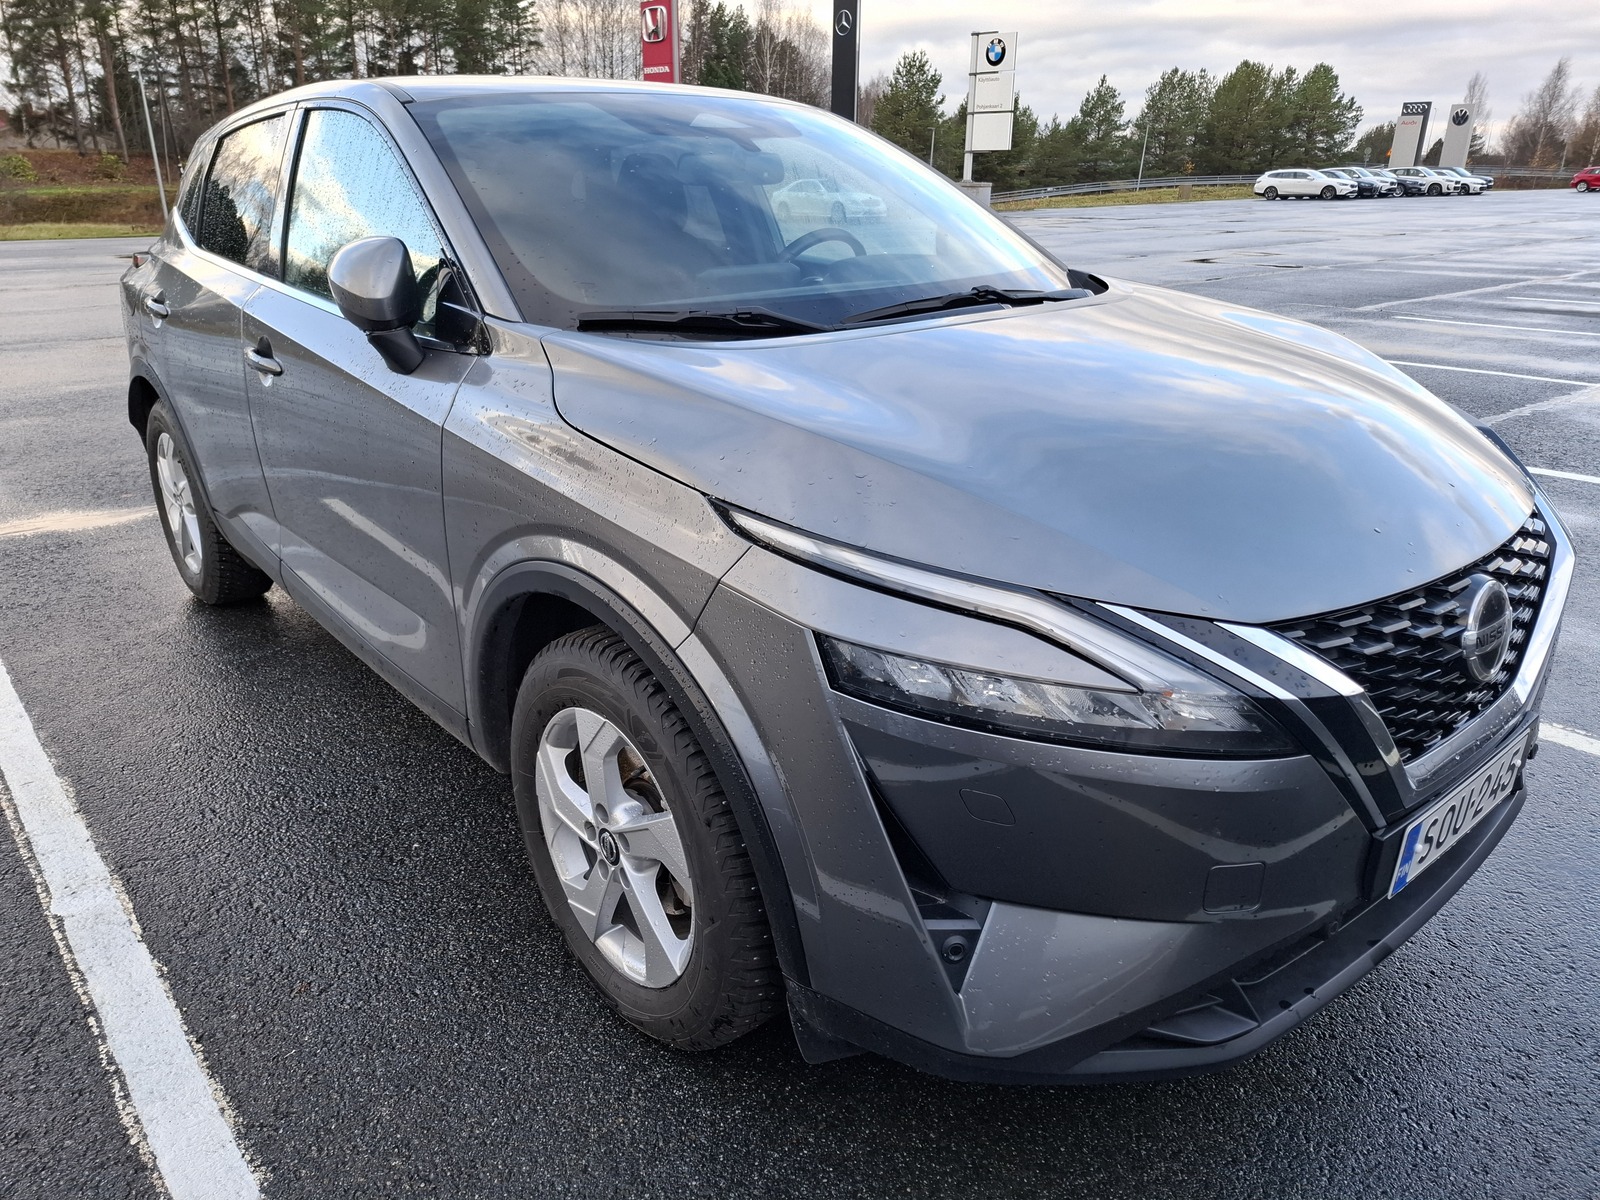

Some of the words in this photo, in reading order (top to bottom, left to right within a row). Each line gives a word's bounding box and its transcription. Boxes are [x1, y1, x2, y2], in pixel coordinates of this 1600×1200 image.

[643, 66, 670, 74] HONDA
[1476, 624, 1505, 650] NISS
[1418, 747, 1521, 864] SOU-245
[1397, 860, 1412, 878] FIN
